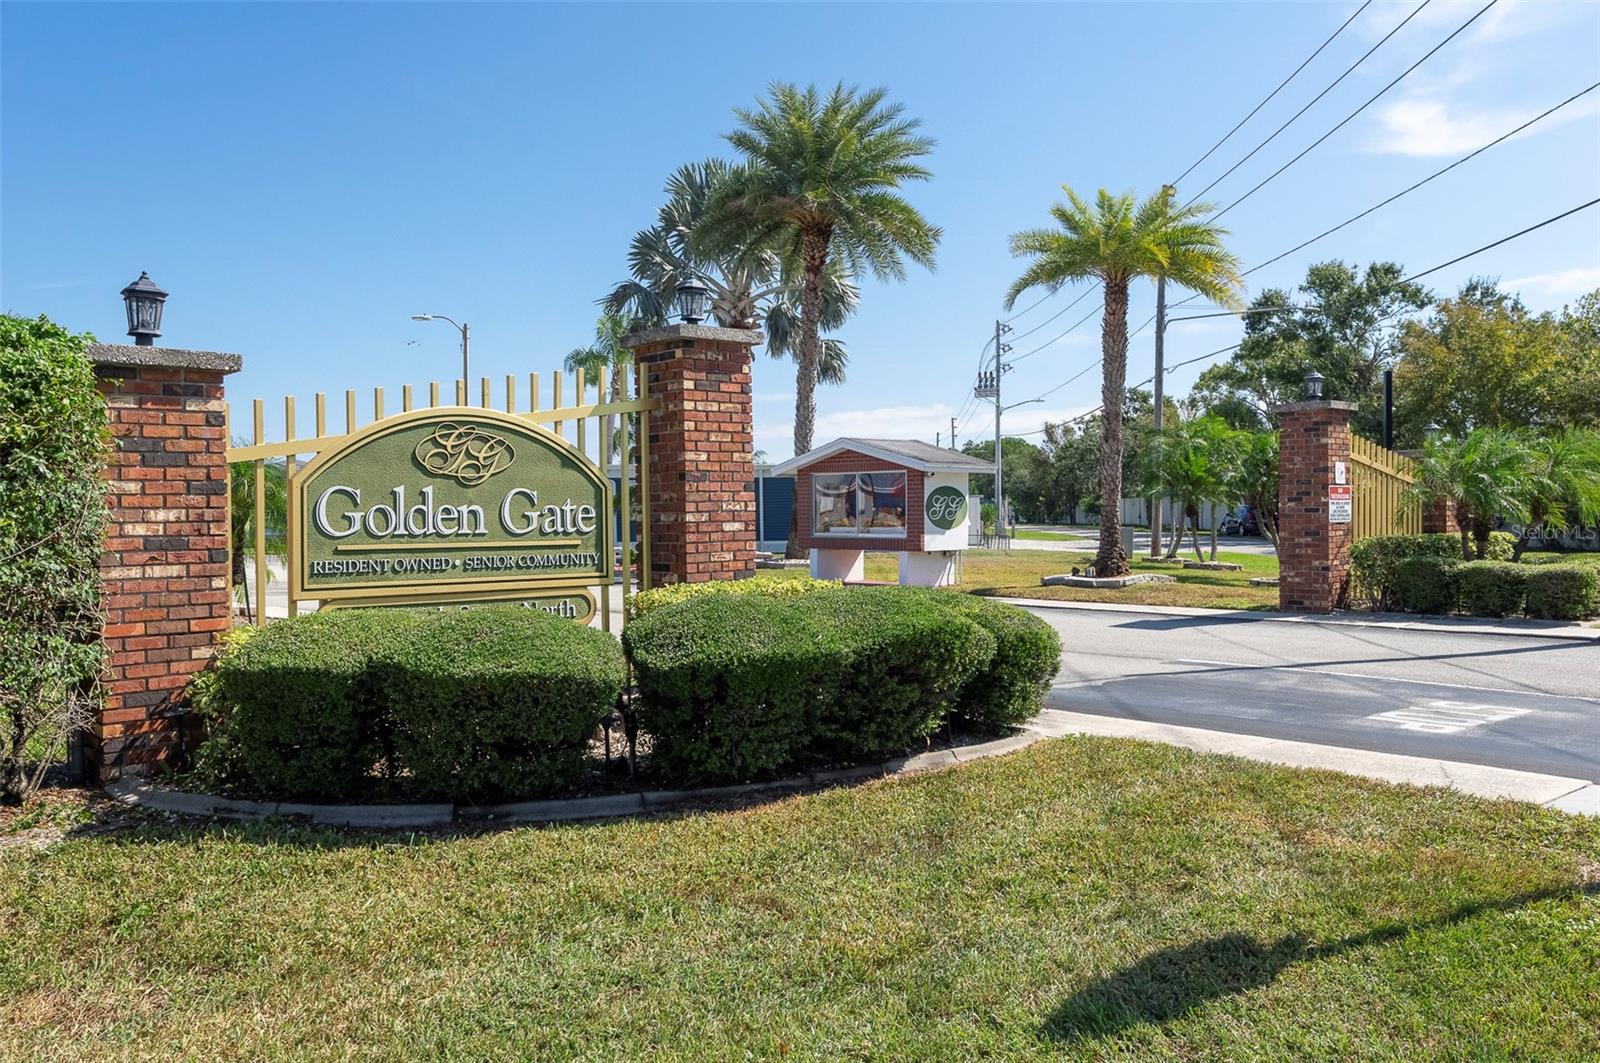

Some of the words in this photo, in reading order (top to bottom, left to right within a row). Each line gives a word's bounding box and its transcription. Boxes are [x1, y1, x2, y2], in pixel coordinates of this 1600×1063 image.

[315, 484, 489, 537] Golden
[500, 487, 597, 535] Gate
[312, 558, 390, 575] RESIDENT
[394, 556, 452, 572] OWNED
[465, 555, 516, 569] SENIOR
[514, 552, 600, 567] COMMUNITY
